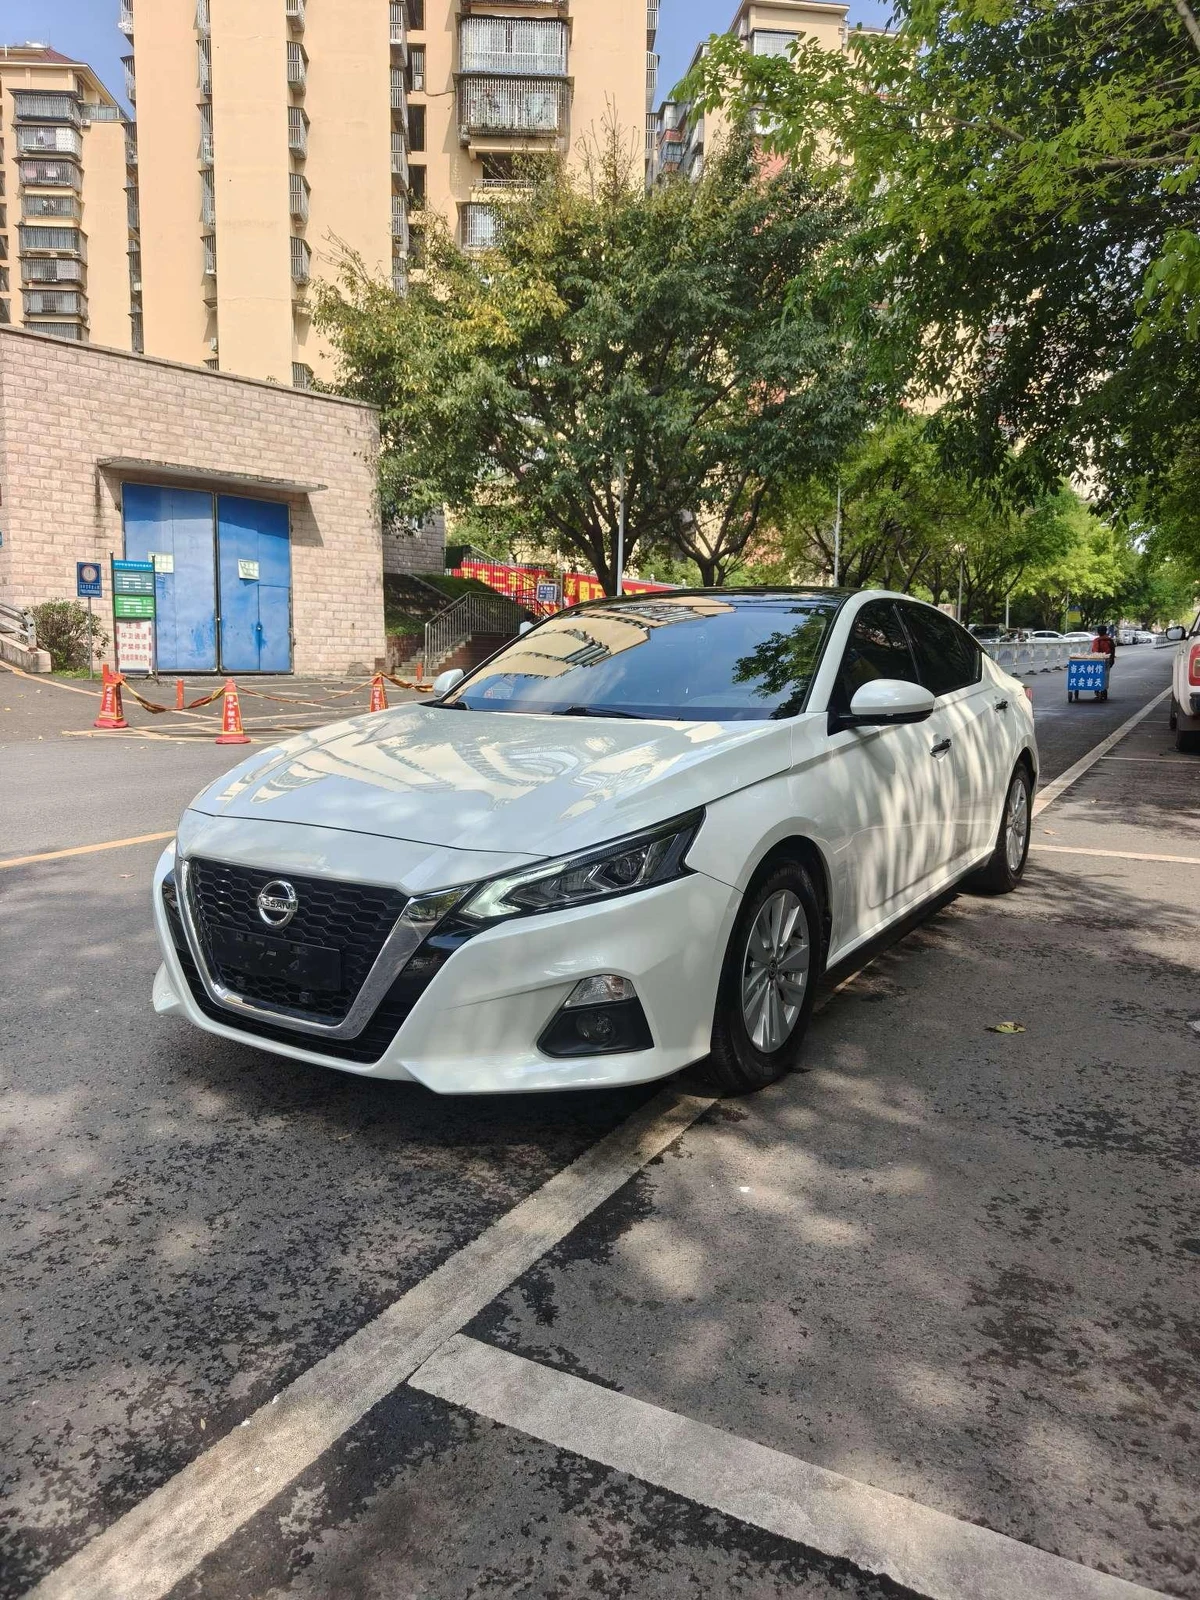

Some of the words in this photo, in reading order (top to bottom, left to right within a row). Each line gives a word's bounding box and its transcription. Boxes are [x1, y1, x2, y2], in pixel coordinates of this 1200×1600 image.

[1071, 664, 1103, 674] 当天制作
[1070, 677, 1102, 687] 只卖当天
